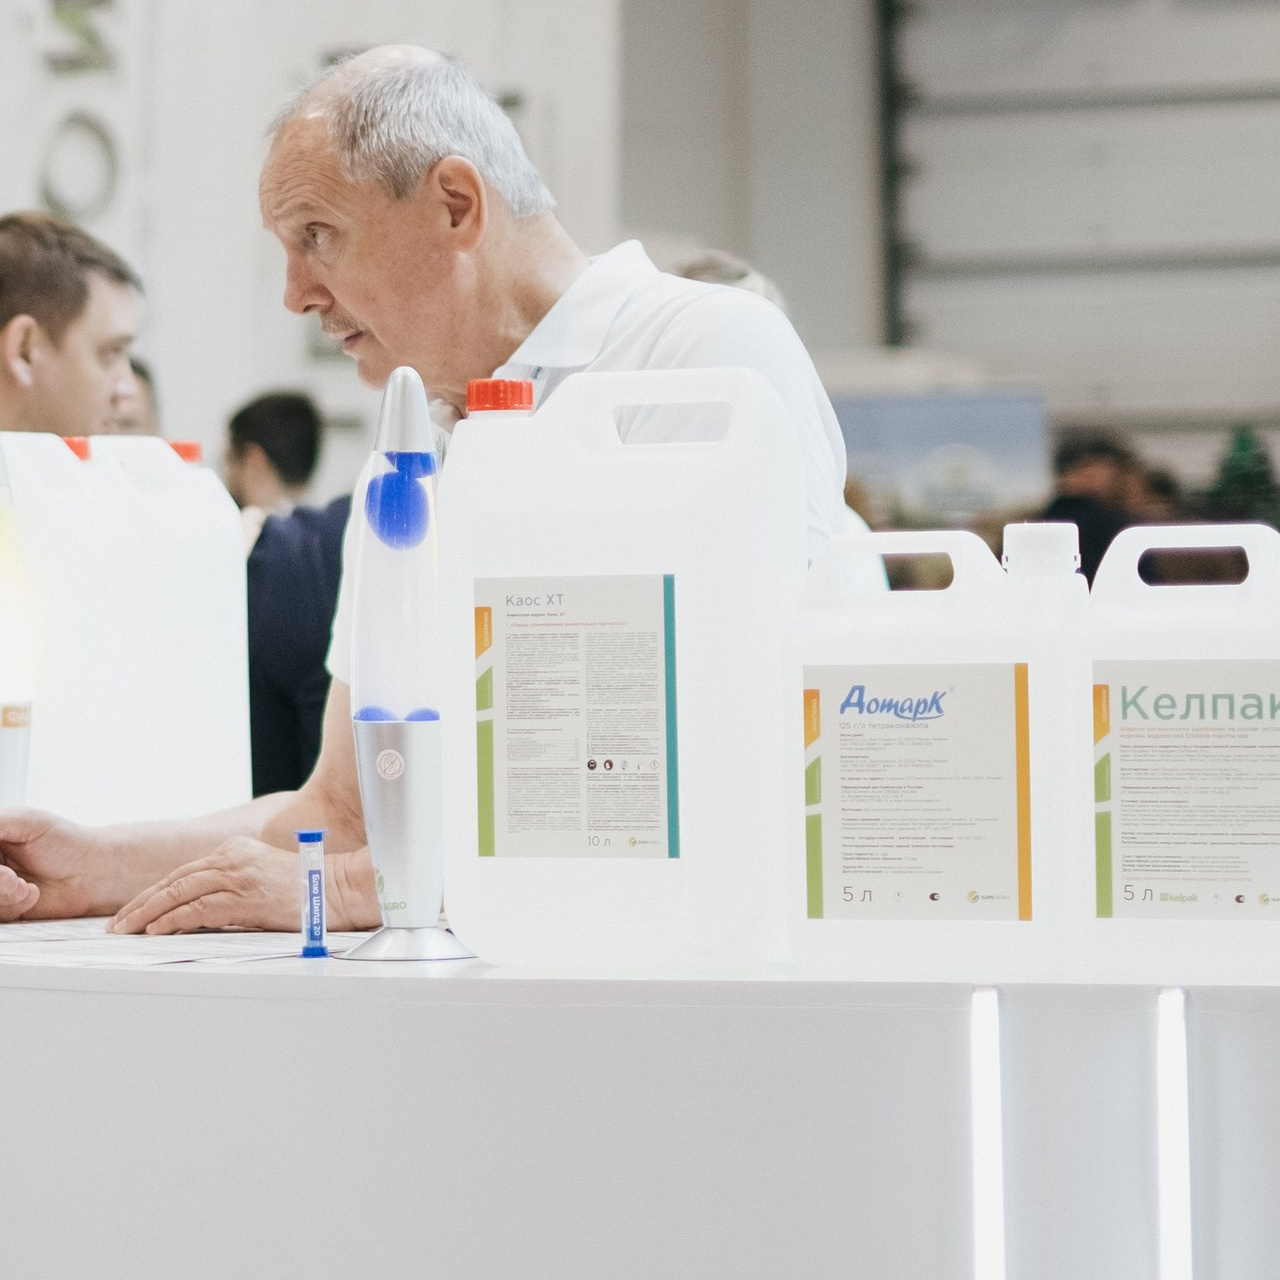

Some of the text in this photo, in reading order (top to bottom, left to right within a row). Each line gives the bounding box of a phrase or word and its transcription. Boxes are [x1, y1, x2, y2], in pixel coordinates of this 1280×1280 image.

[505, 593, 564, 607] Каос ХТ
[587, 835, 611, 846] 10 л
[843, 886, 872, 902] 5 л
[1123, 884, 1153, 901] 5 л
[312, 873, 321, 936] Блю Шилд 20
